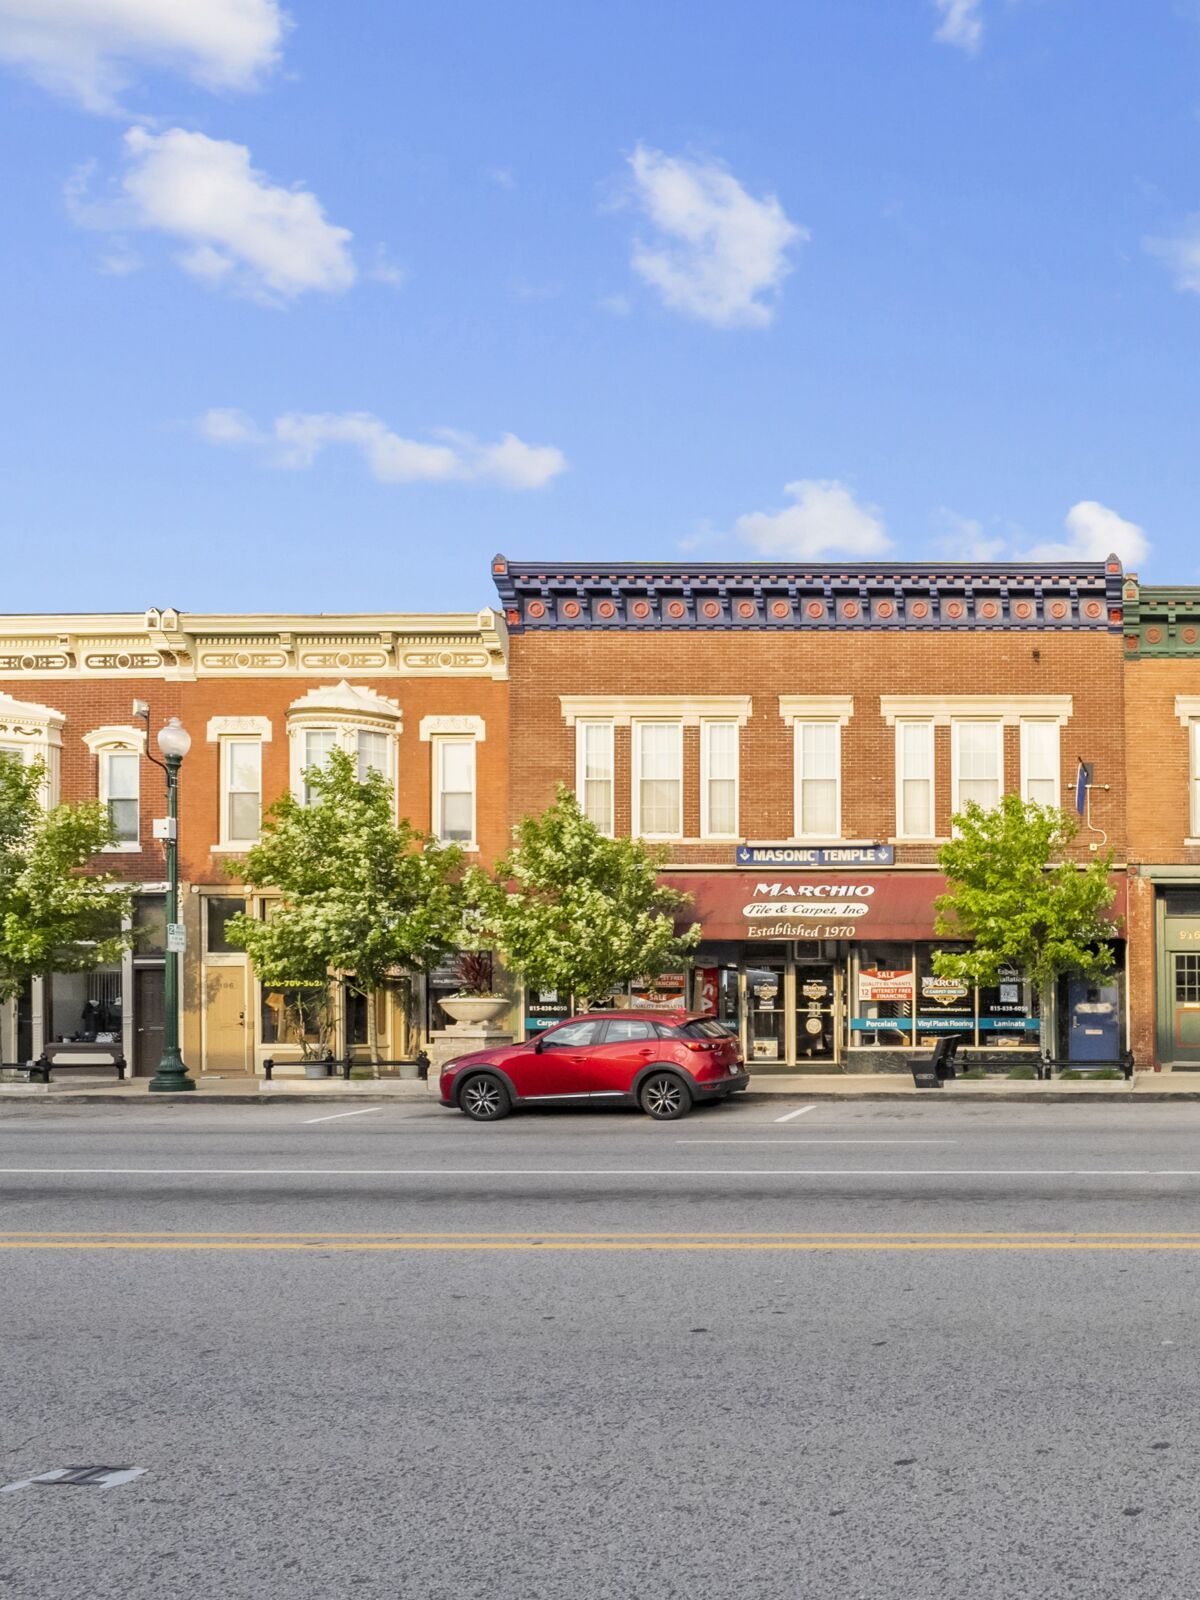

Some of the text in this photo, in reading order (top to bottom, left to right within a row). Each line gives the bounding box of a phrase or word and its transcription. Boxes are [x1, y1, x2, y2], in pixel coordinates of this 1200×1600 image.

[753, 849, 875, 862] MASONIC TEMPLE
[752, 883, 875, 897] MARCHIO
[748, 904, 865, 916] Tile & Carpet, Inc.
[747, 923, 856, 938] Established 1970
[876, 970, 896, 979] SALE
[649, 993, 667, 1001] SALE
[861, 988, 869, 996] 12
[917, 1020, 933, 1028] Vinyl
[949, 1020, 974, 1028] Flooring
